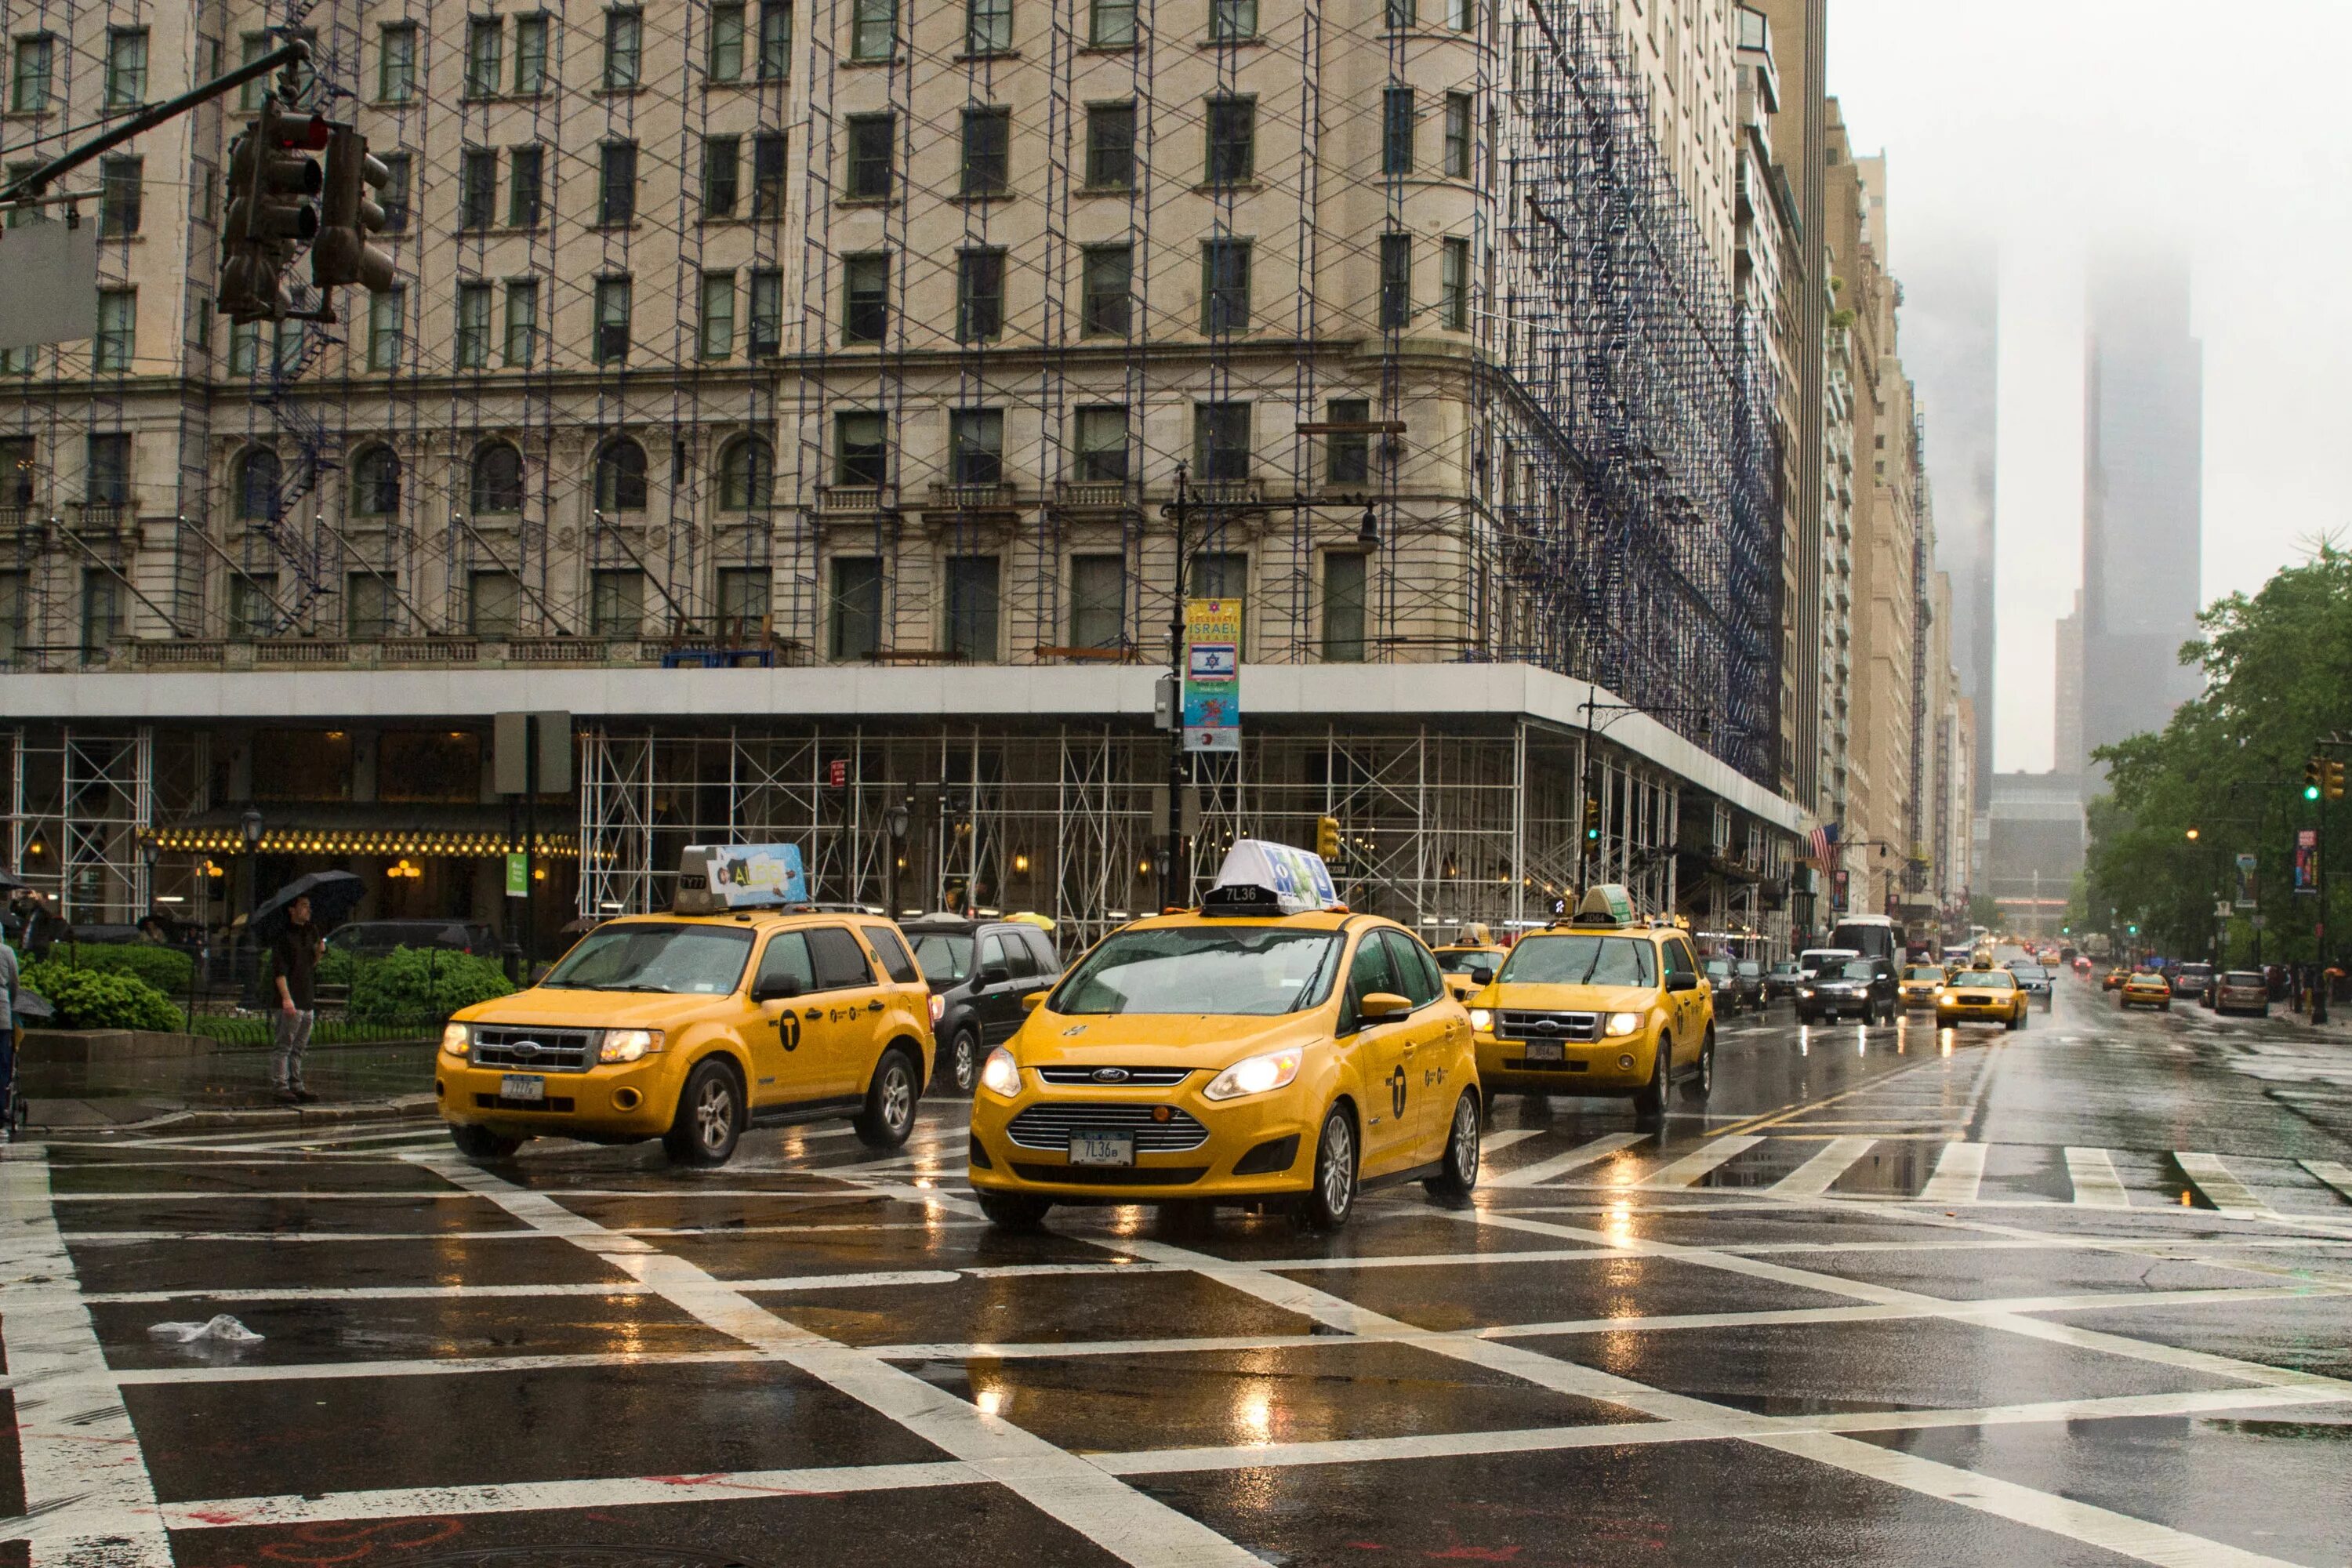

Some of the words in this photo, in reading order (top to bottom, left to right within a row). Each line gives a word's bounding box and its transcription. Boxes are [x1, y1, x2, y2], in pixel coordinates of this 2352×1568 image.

[1189, 622, 1237, 634] ISRAEL
[735, 865, 781, 885] ALDO
[1226, 887, 1255, 901] 7L36
